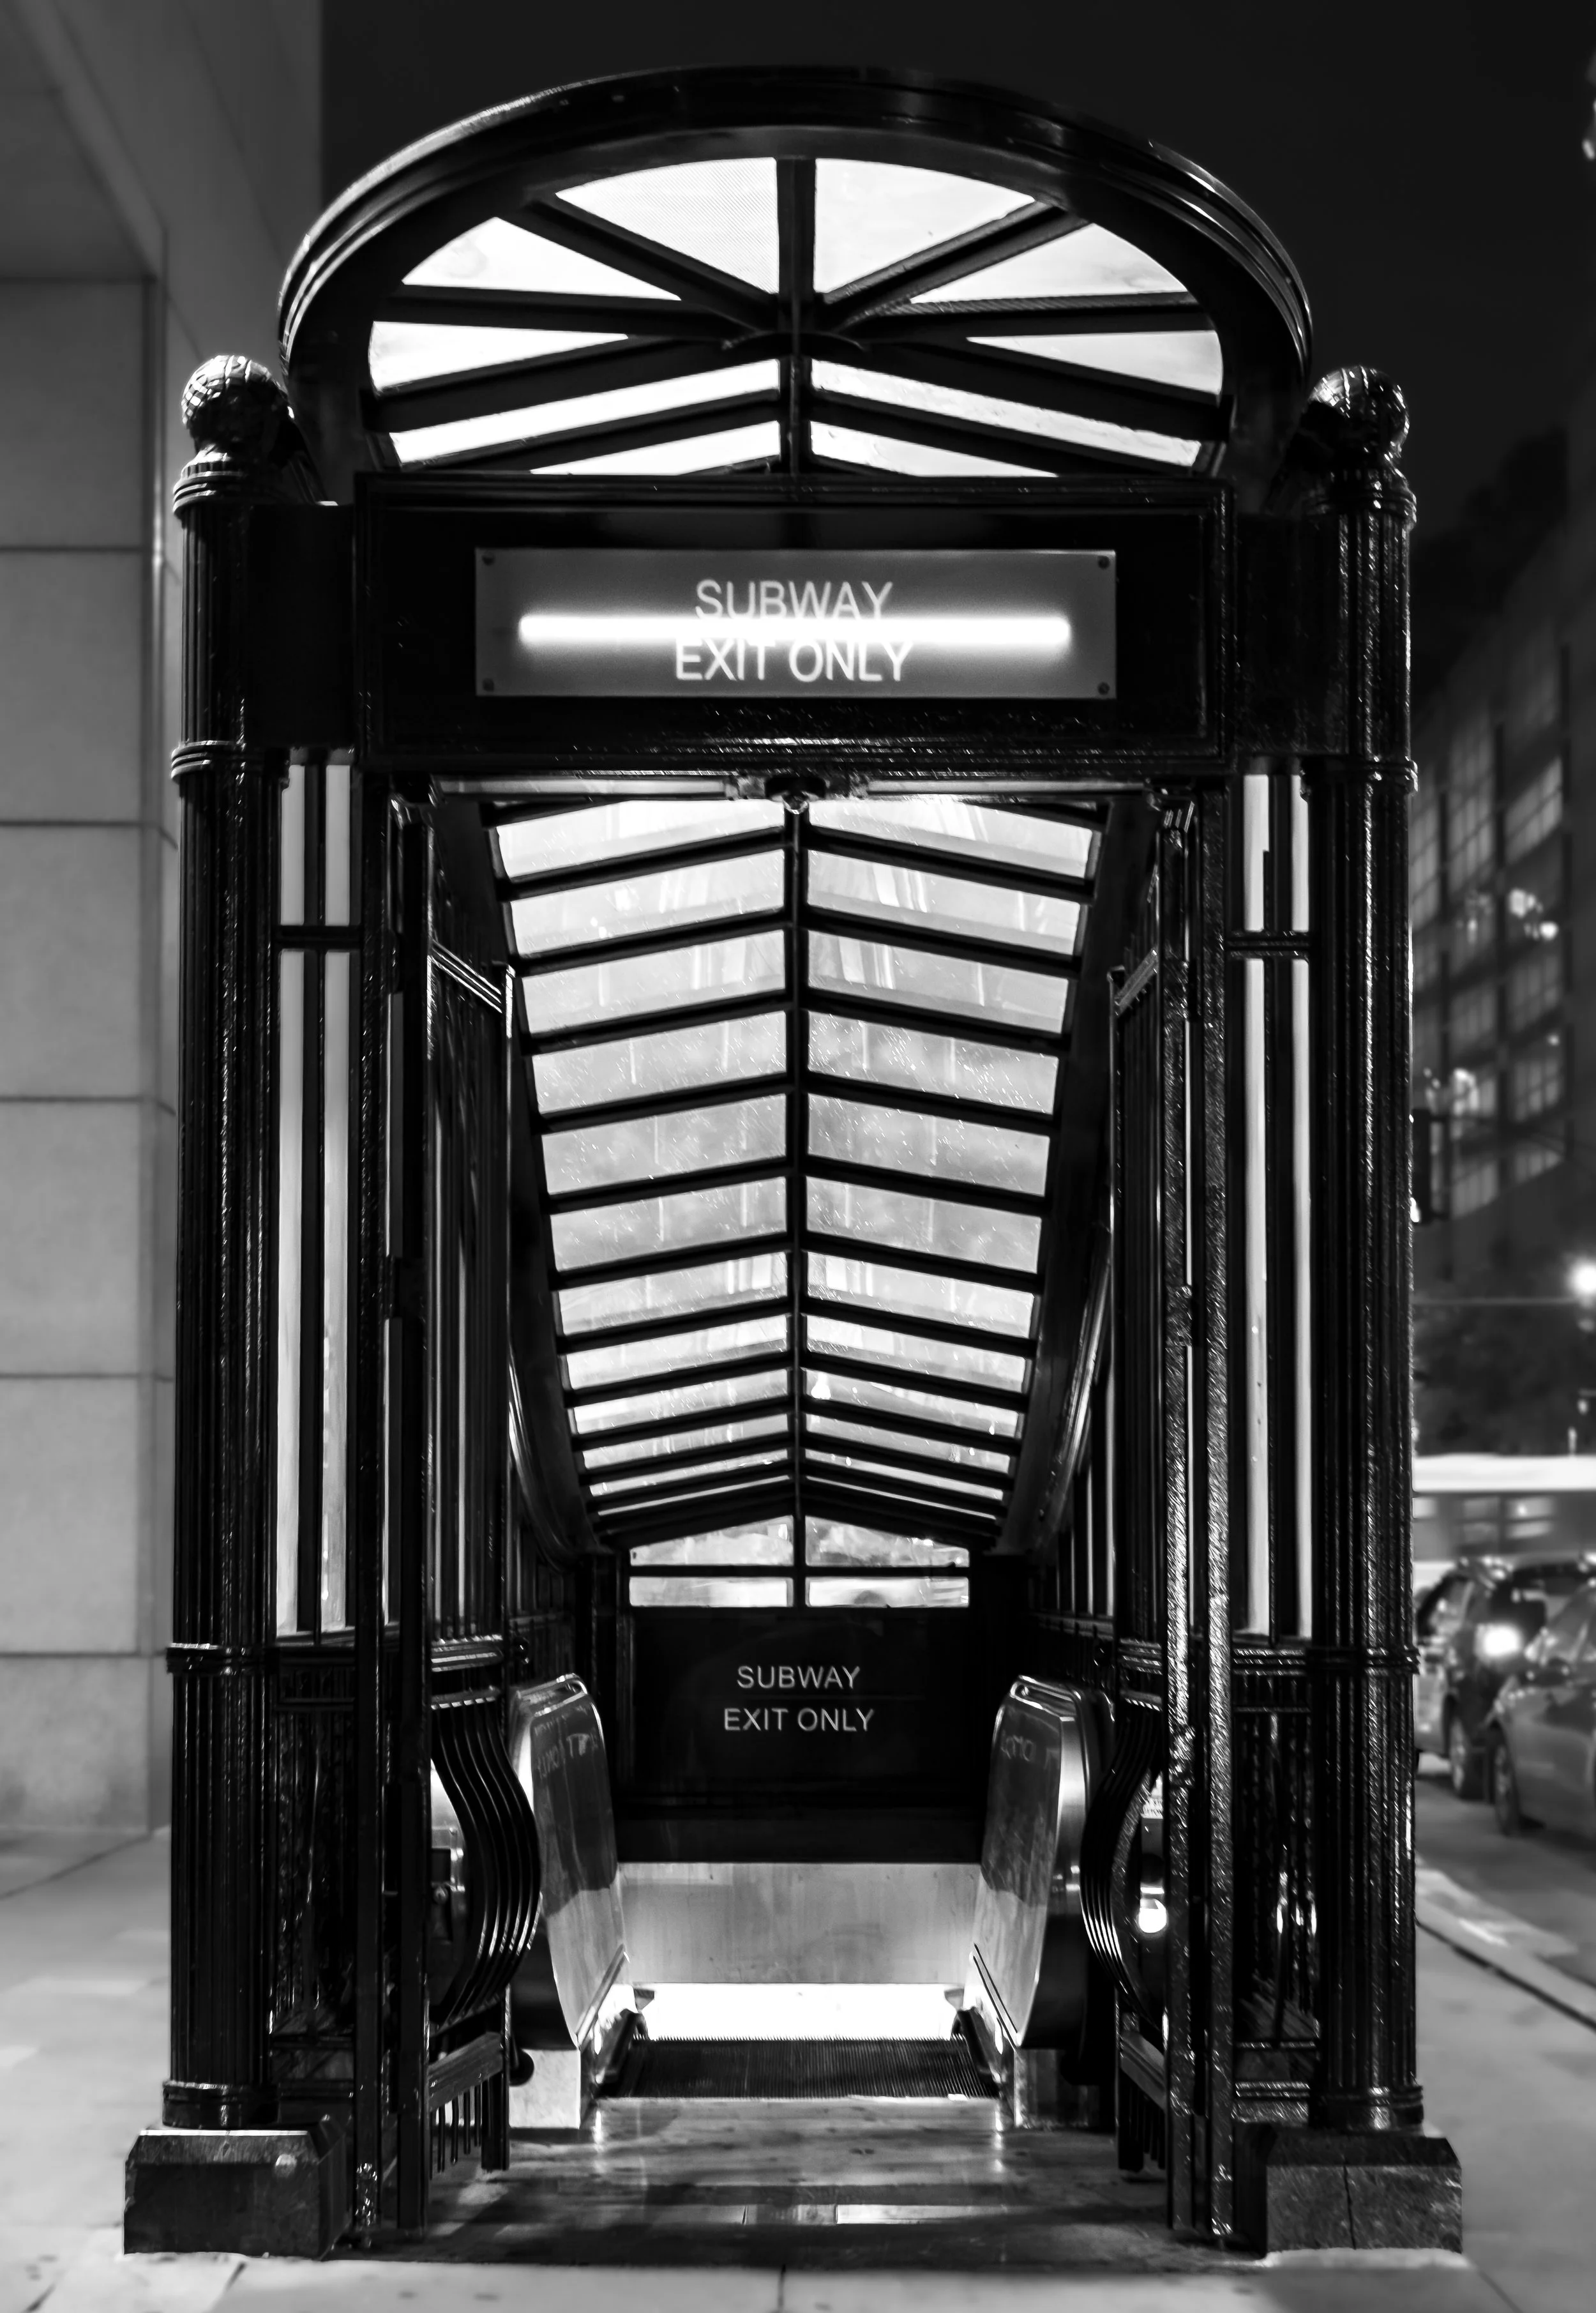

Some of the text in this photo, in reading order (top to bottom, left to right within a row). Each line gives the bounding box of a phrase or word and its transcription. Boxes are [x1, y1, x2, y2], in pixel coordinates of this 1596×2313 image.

[695, 579, 892, 619] SUBWAY
[675, 638, 914, 682] EXIT ONLY
[736, 1665, 860, 1689] SUBWAY
[723, 1708, 874, 1731] EXIT ONLY
